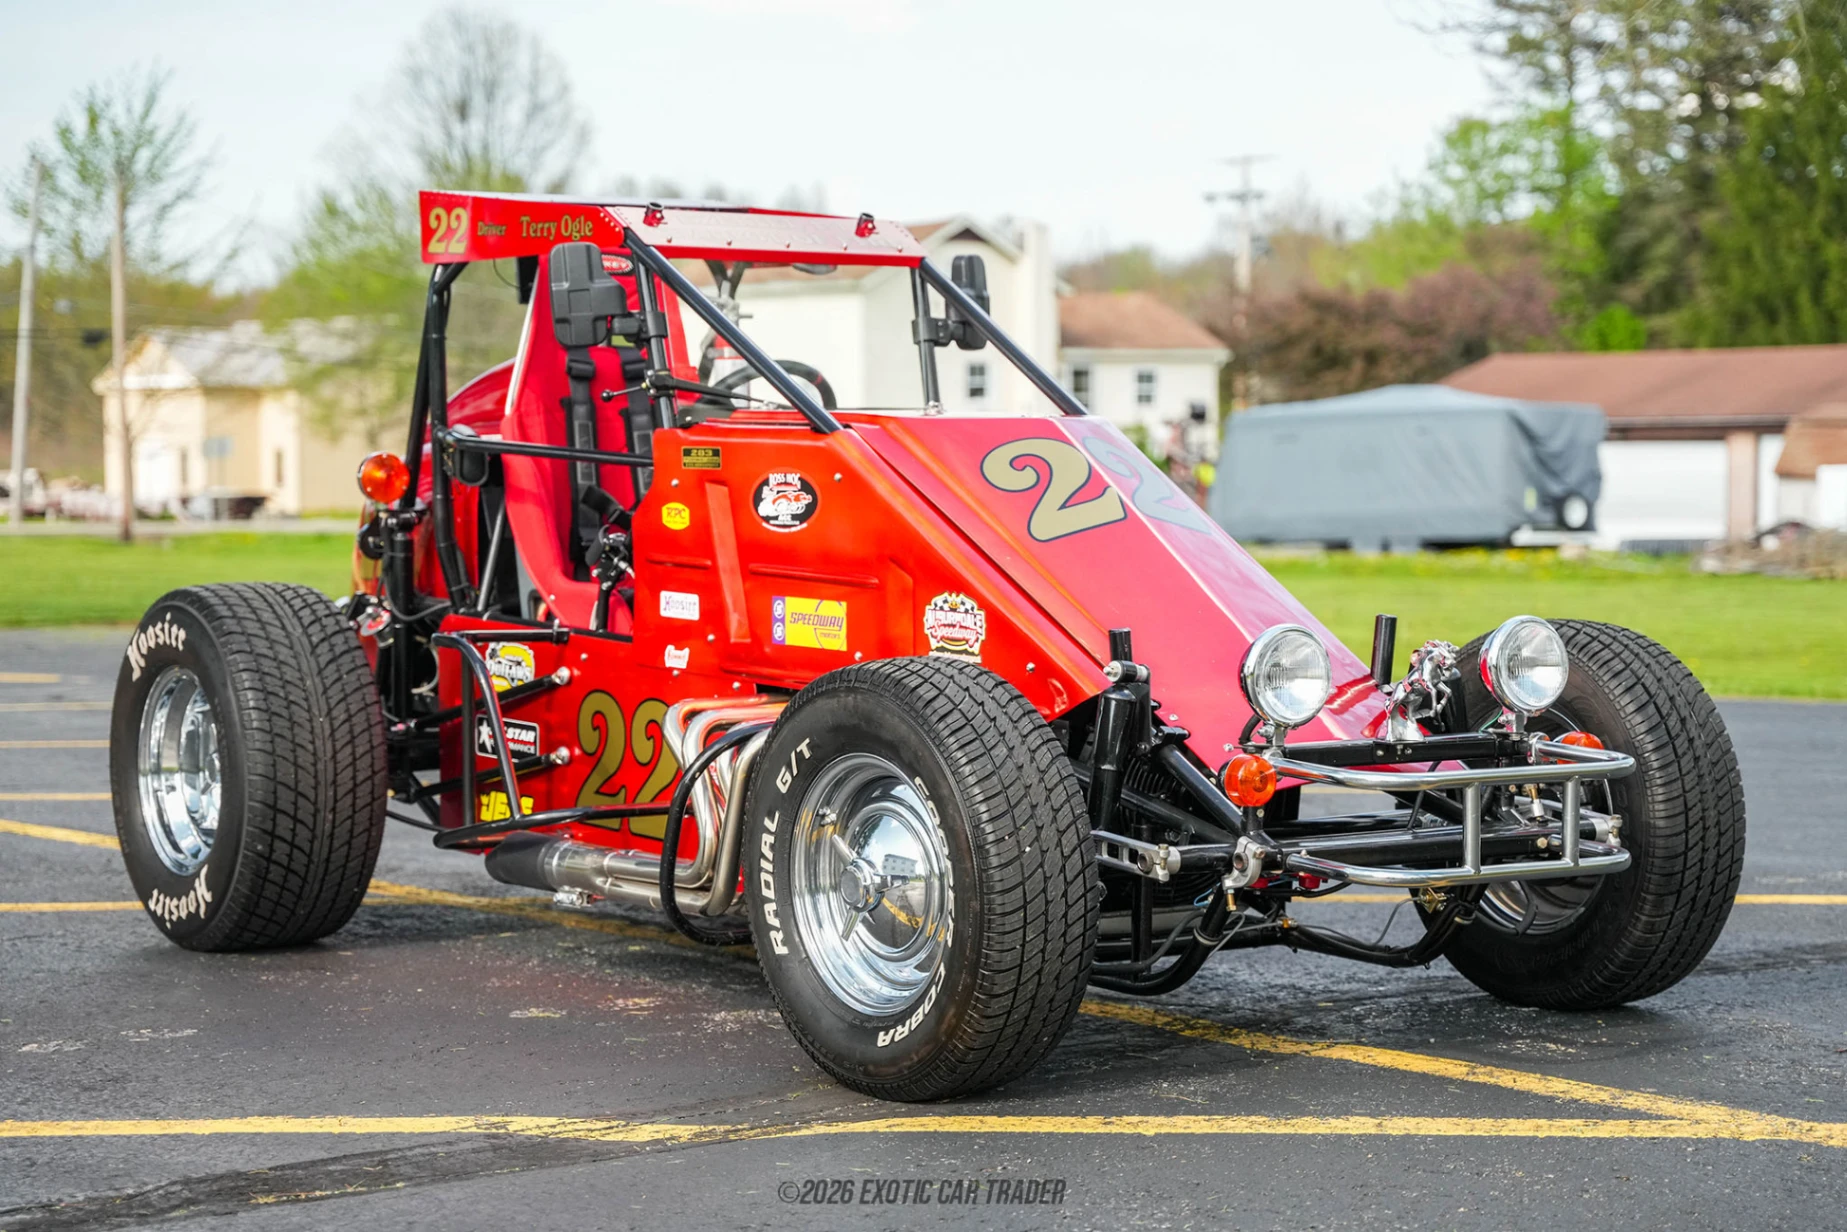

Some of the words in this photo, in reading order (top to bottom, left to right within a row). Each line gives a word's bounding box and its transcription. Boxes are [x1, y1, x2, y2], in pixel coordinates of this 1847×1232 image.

[428, 207, 468, 254] 22
[477, 221, 507, 236] Driver
[520, 215, 557, 240] Terry
[560, 215, 594, 241] Ogle
[127, 611, 187, 682] Hoosier
[789, 612, 844, 631] SPEEDWAY
[776, 738, 811, 794] G/T
[760, 811, 789, 955] RADIAL
[877, 962, 946, 1048] COBRA
